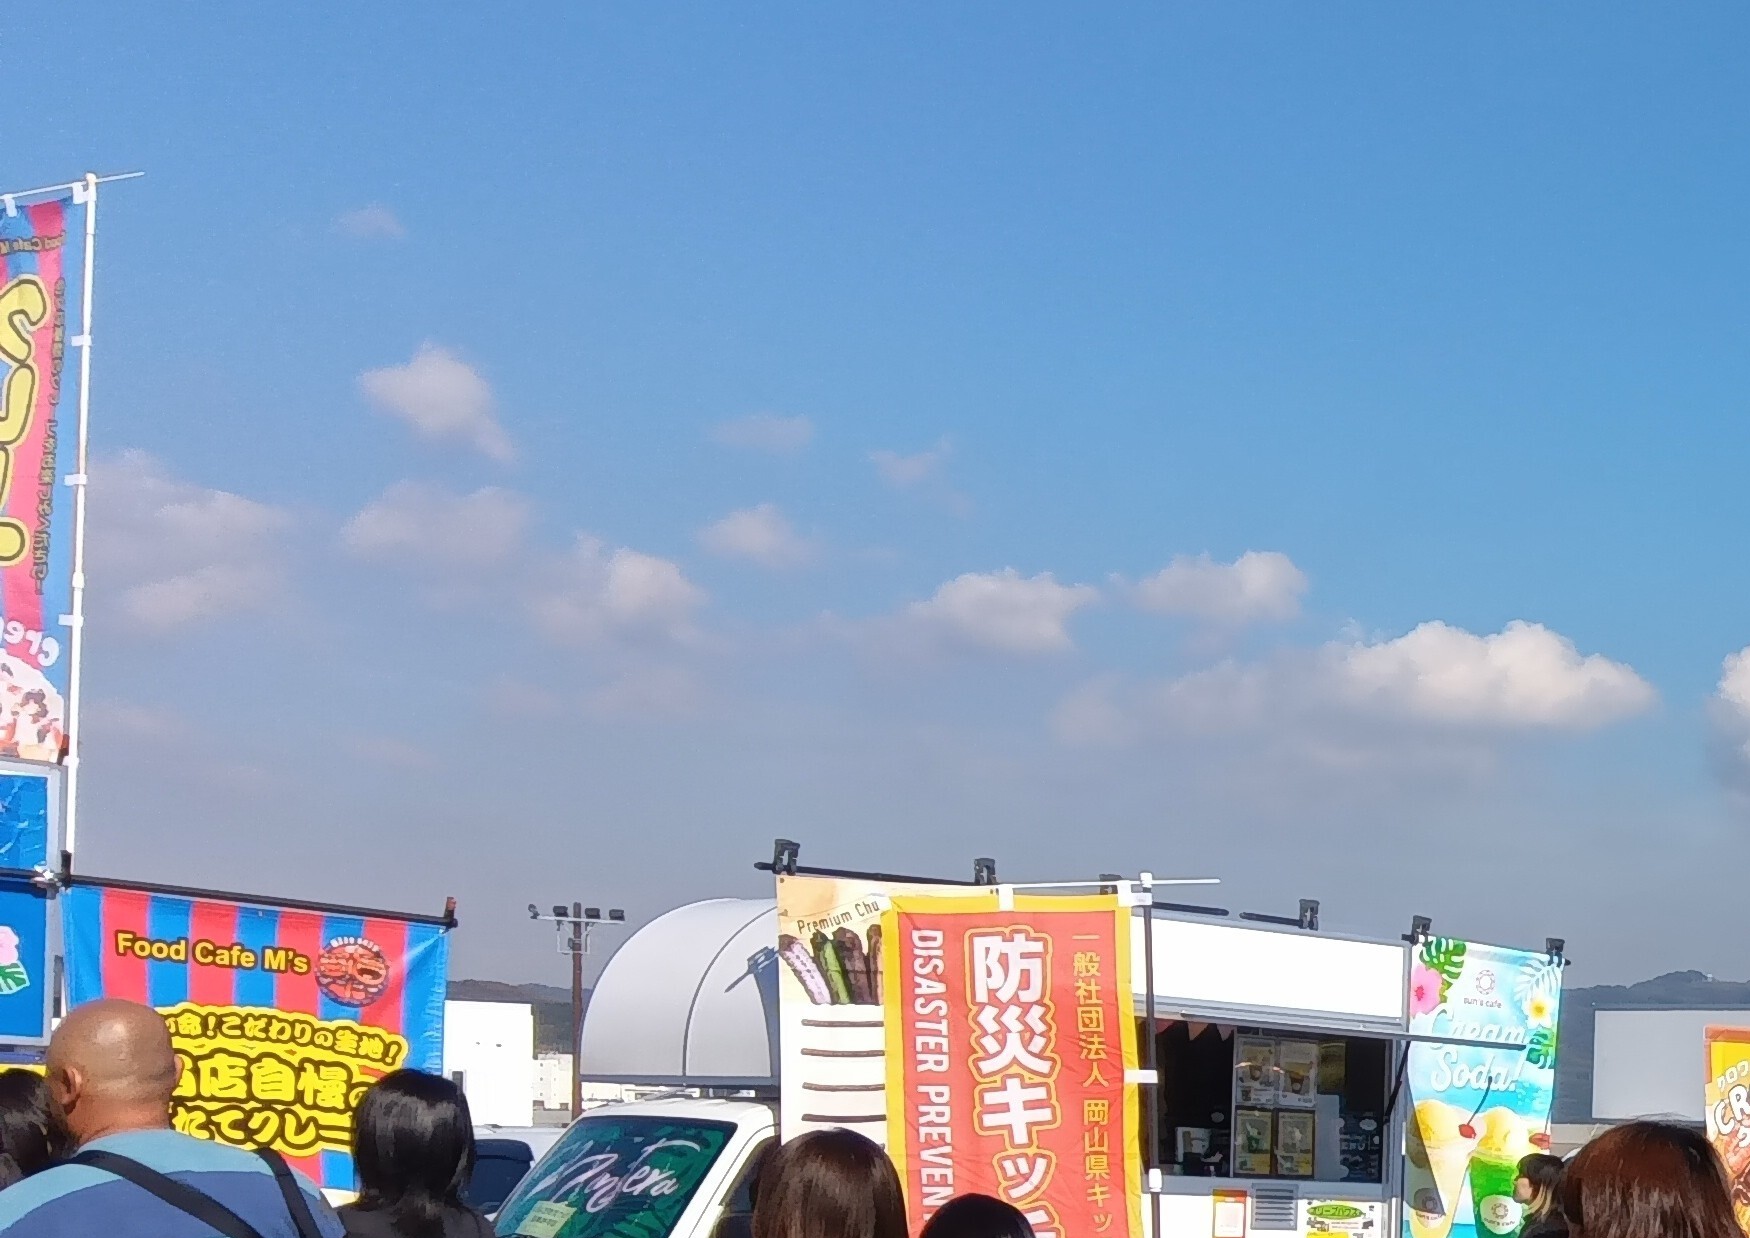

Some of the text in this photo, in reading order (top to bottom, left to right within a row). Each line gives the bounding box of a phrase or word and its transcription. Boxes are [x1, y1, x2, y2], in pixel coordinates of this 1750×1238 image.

[796, 910, 853, 935] Premium
[116, 932, 309, 974] Food Cafe M's
[1072, 934, 1110, 1088] 一般社団法人
[1431, 1009, 1526, 1049] Cream
[911, 930, 955, 1221] DISASTER PREVEN
[1430, 1050, 1525, 1092] Soda!
